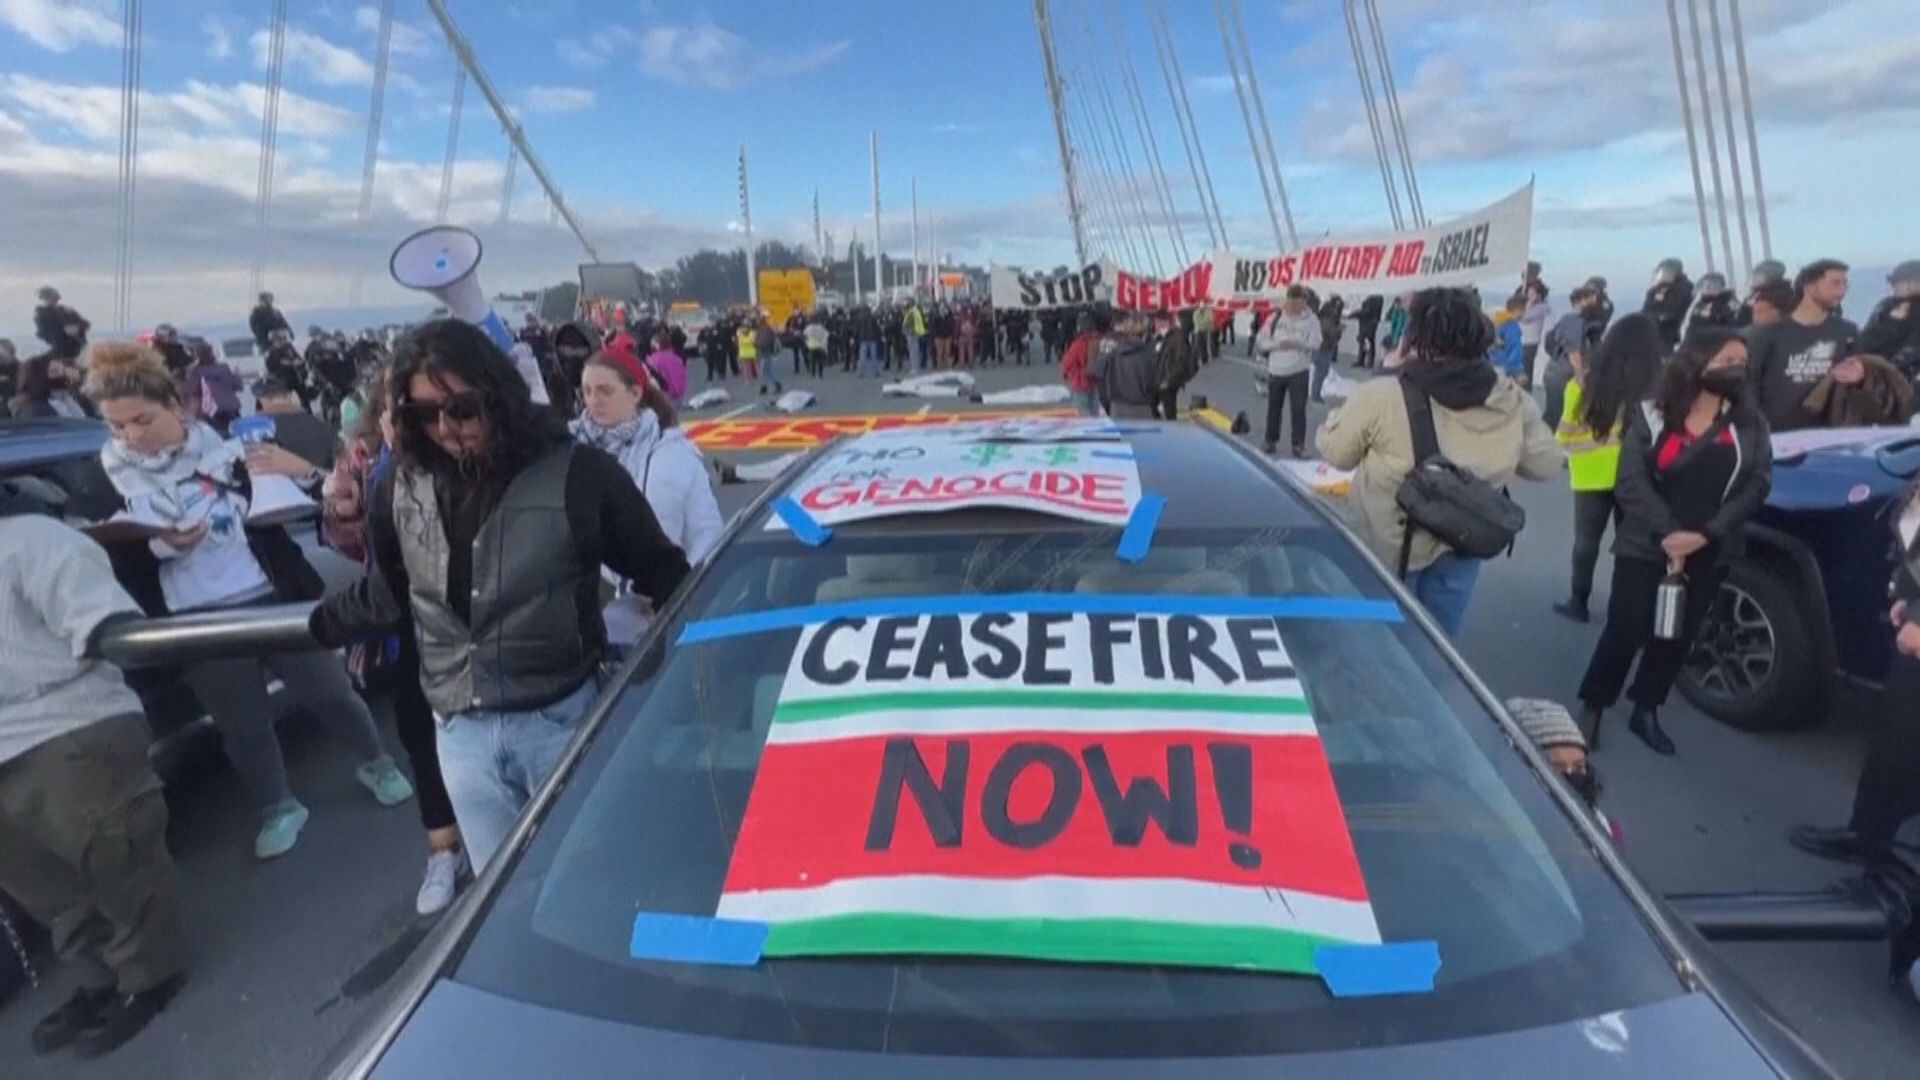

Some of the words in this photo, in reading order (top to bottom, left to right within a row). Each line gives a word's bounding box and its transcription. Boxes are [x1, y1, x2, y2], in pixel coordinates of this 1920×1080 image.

[1017, 262, 1102, 307] STOP
[1234, 258, 1267, 291] NO
[1268, 255, 1297, 288] US
[1300, 244, 1387, 280] MILITARY
[1387, 240, 1425, 277] AID
[1432, 222, 1490, 274] ISRAEL
[800, 470, 1128, 512] GENOCIDE
[864, 738, 1263, 869] NOW!
